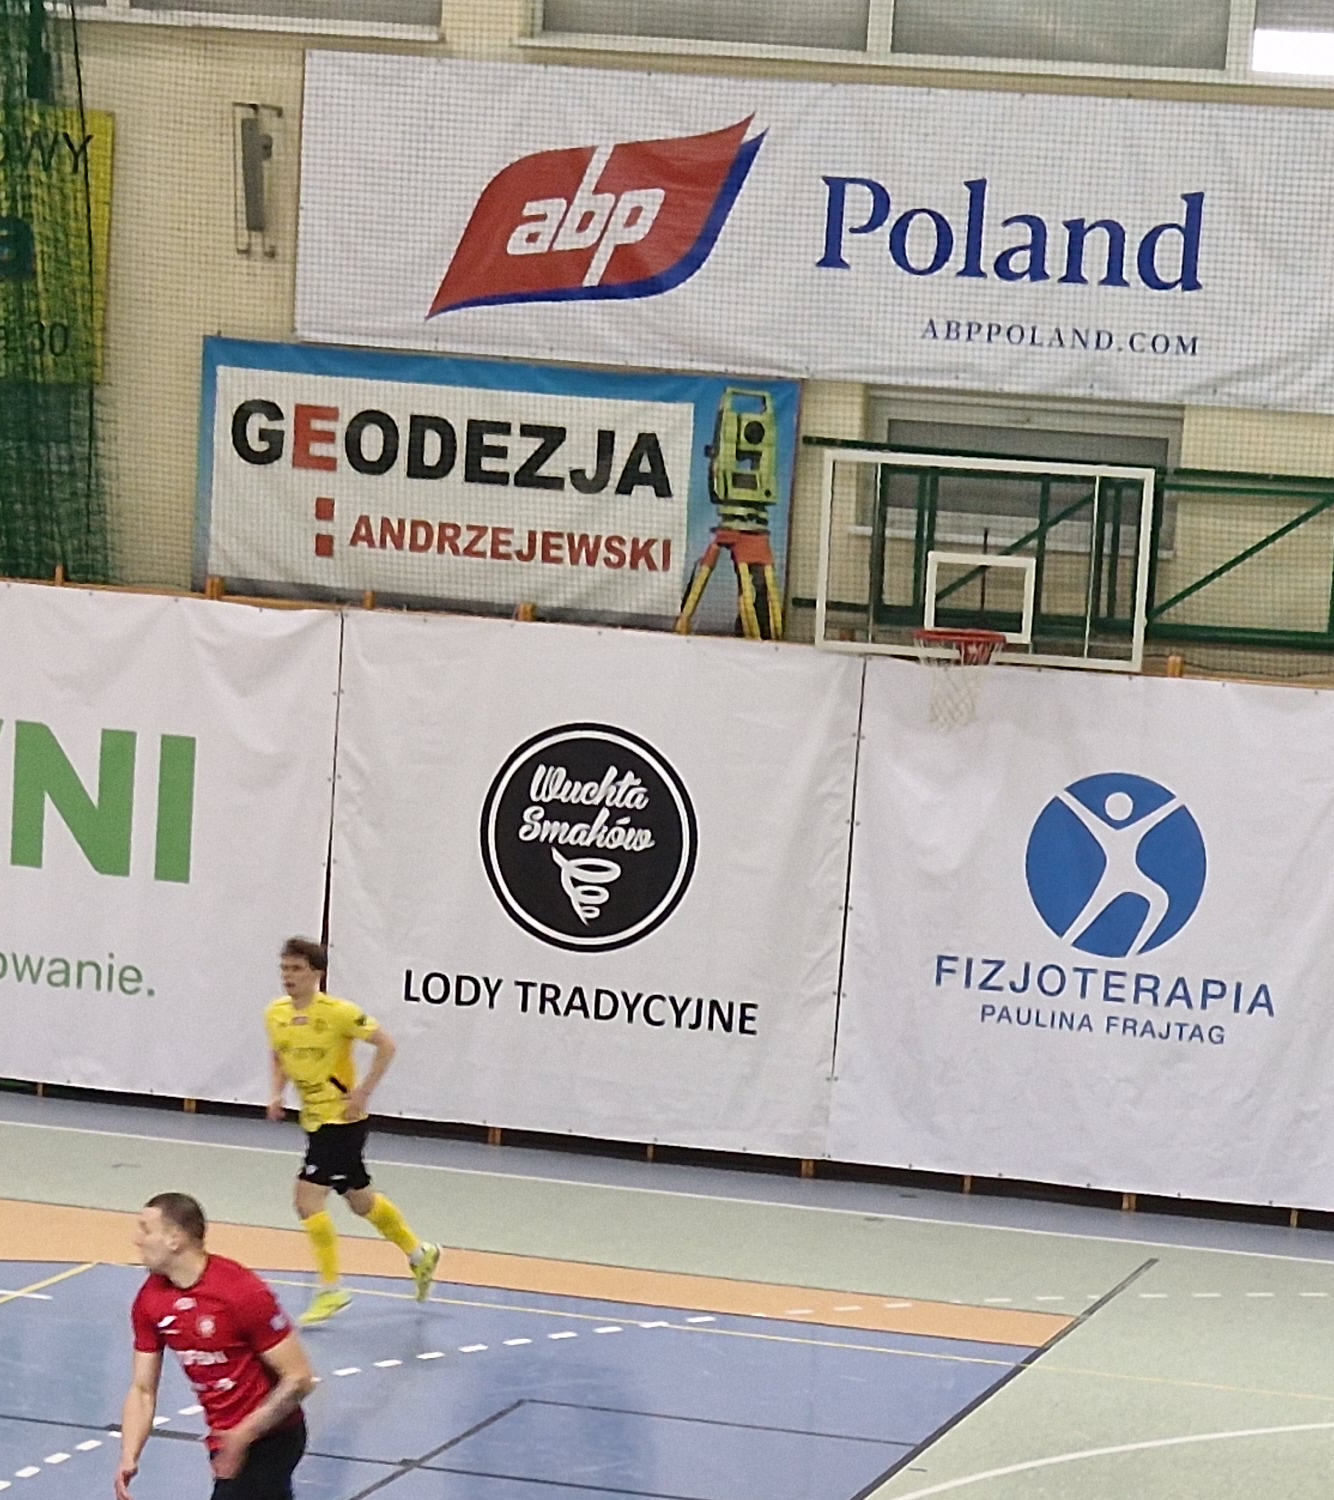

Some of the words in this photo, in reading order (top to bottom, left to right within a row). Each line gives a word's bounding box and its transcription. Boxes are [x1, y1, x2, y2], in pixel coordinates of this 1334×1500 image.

[507, 146, 667, 285] abp
[816, 176, 1204, 293] Poland
[922, 319, 1200, 356] ABPPOLAND.COM
[228, 398, 673, 500] GEODEZJA
[350, 516, 672, 574] ANDRZEJEWSKI
[530, 763, 649, 811] Wuchta
[518, 806, 656, 852] Smaków
[403, 969, 503, 1010] LODY
[514, 980, 759, 1036] TRADYCYJNE
[934, 954, 1276, 1018] FIZJOTERAPIA
[980, 1004, 1093, 1033] PAULINA
[1106, 1016, 1226, 1045] FRAJTAG
